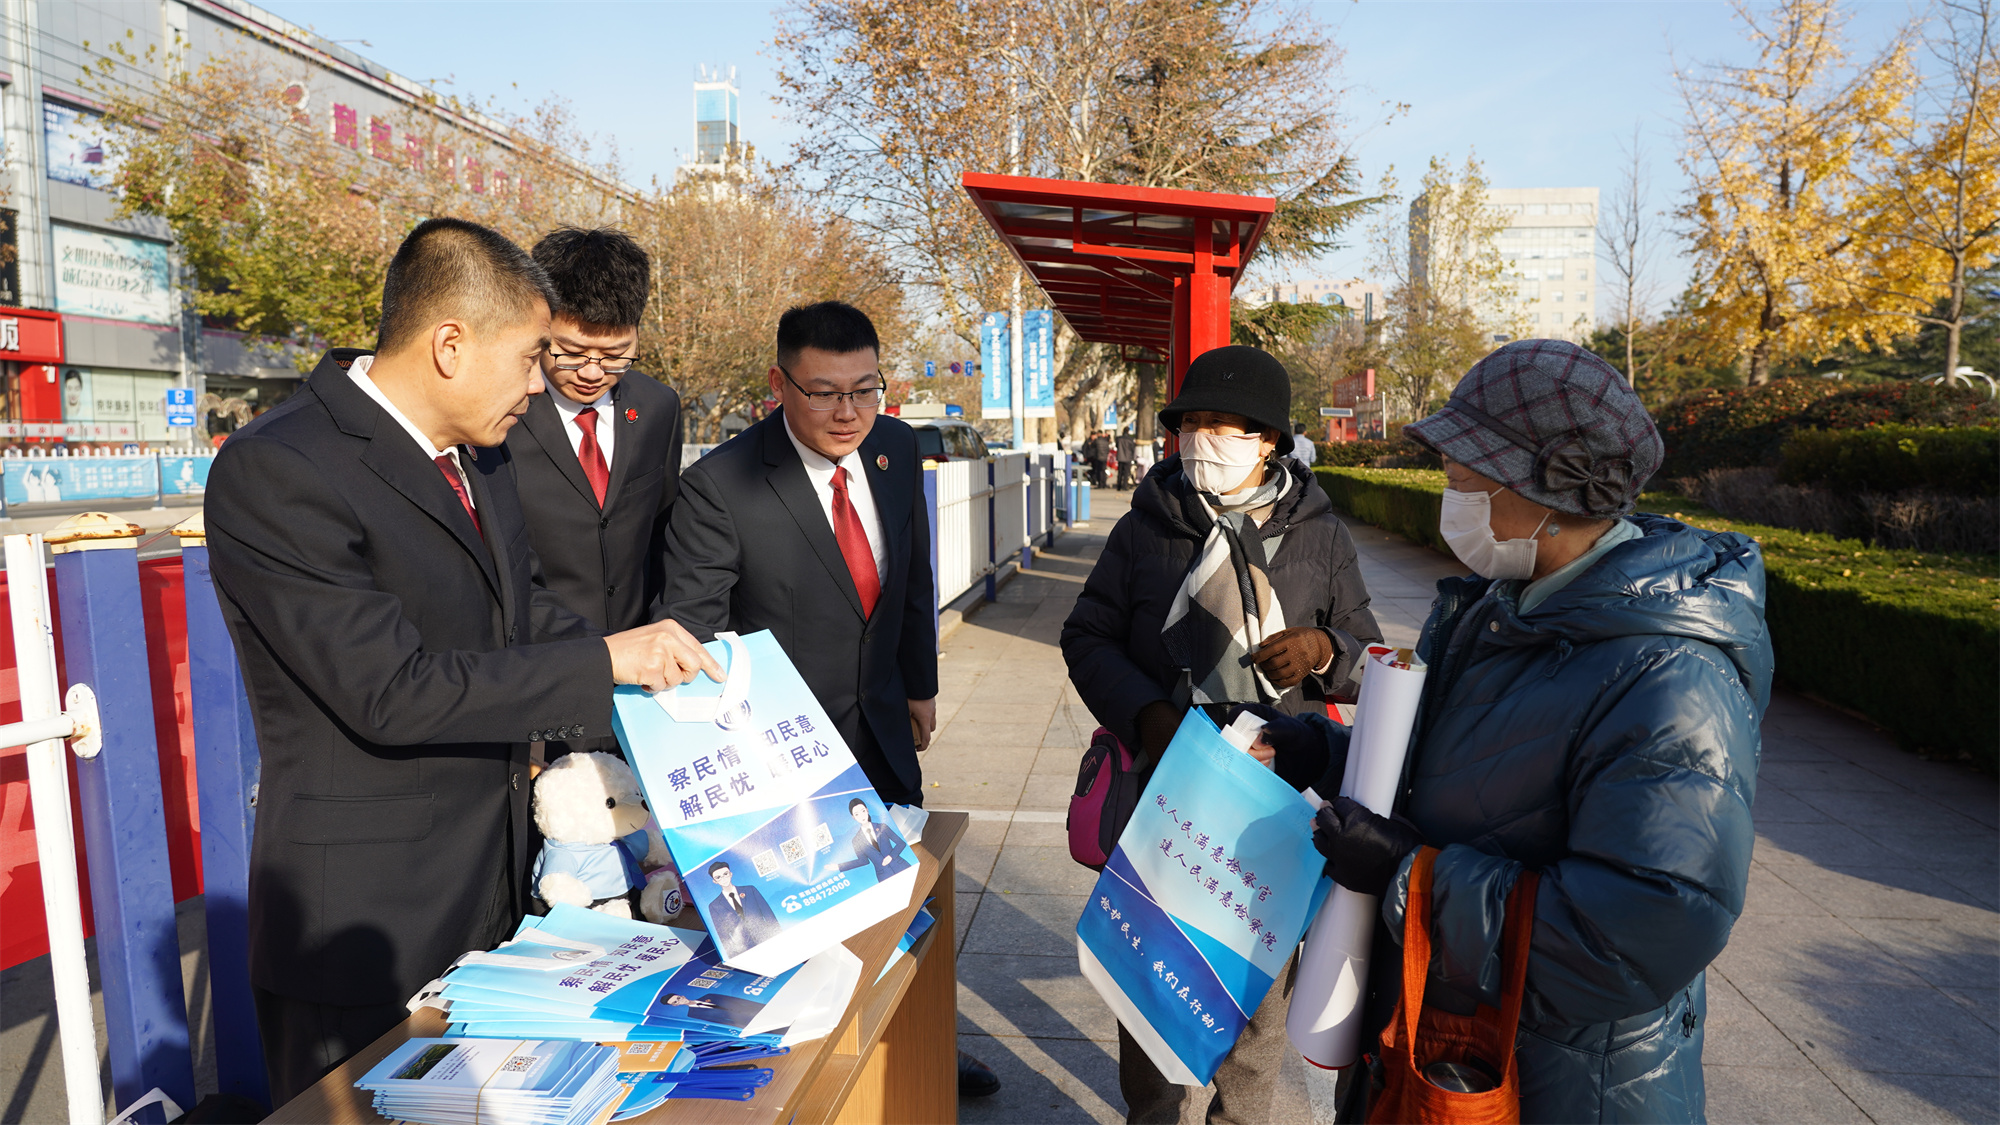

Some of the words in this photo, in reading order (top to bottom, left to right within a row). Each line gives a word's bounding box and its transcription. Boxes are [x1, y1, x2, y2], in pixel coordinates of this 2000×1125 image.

[62, 266, 153, 294] 诚信是立身之本
[667, 744, 742, 792] 察民情
[679, 771, 755, 820] 解民忧
[1155, 793, 1273, 902] 做人民满意检察官
[802, 879, 851, 907] 88472000
[1159, 838, 1277, 952] 建人民满意检察院
[559, 960, 614, 988] 察民情
[588, 963, 642, 993] 解民忧
[634, 938, 681, 962] 暖民心
